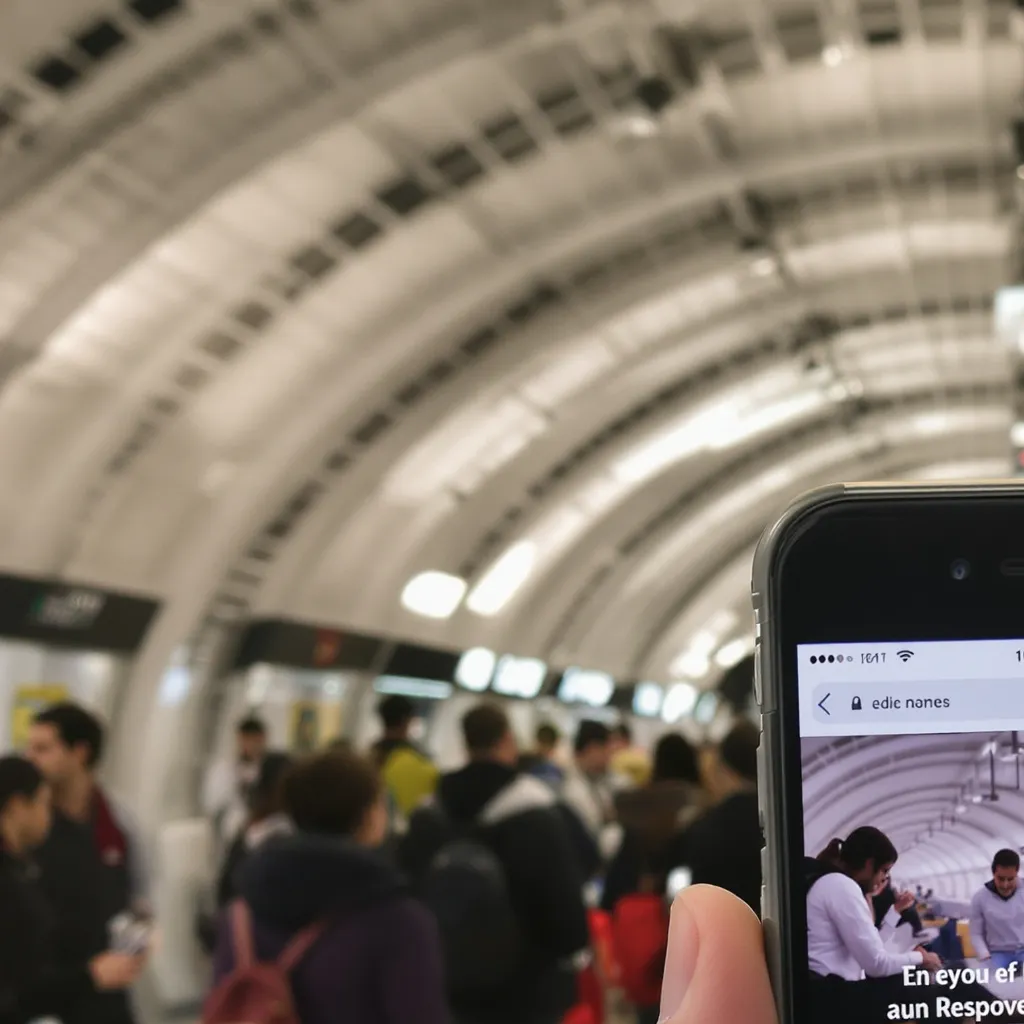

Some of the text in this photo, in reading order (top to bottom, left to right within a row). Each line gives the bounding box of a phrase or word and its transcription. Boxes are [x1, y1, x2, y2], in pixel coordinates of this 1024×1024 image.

[902, 965, 930, 986] En
[935, 967, 989, 989] eyou
[995, 961, 1018, 983] ef
[887, 1001, 929, 1020] aun
